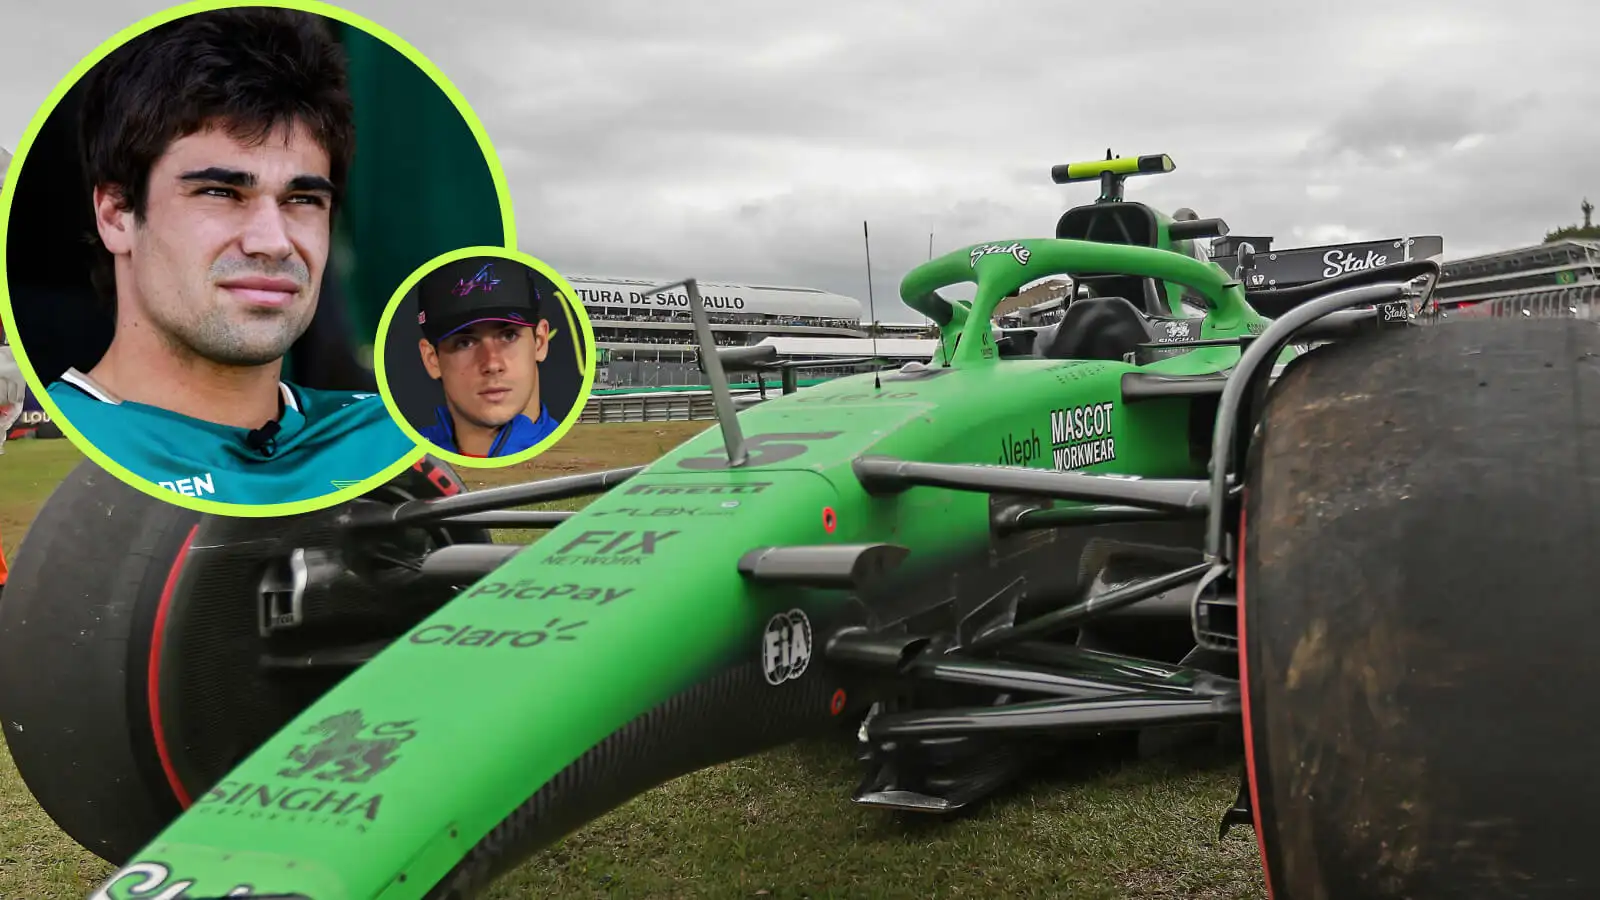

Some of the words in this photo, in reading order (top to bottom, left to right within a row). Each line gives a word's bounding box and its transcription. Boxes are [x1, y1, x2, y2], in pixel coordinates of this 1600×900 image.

[970, 243, 1031, 269] Stake
[1322, 249, 1388, 279] Stake
[631, 292, 651, 304] DE
[1050, 401, 1114, 444] MASCOT
[676, 430, 846, 471] 5
[1053, 437, 1116, 472] WORKWEAR
[623, 482, 774, 496] PIRELLI
[556, 530, 681, 555] FIX
[540, 554, 650, 566] NETWORK
[466, 579, 636, 606] PicPay
[409, 623, 548, 648] Claro
[200, 780, 384, 821] SINGHA
